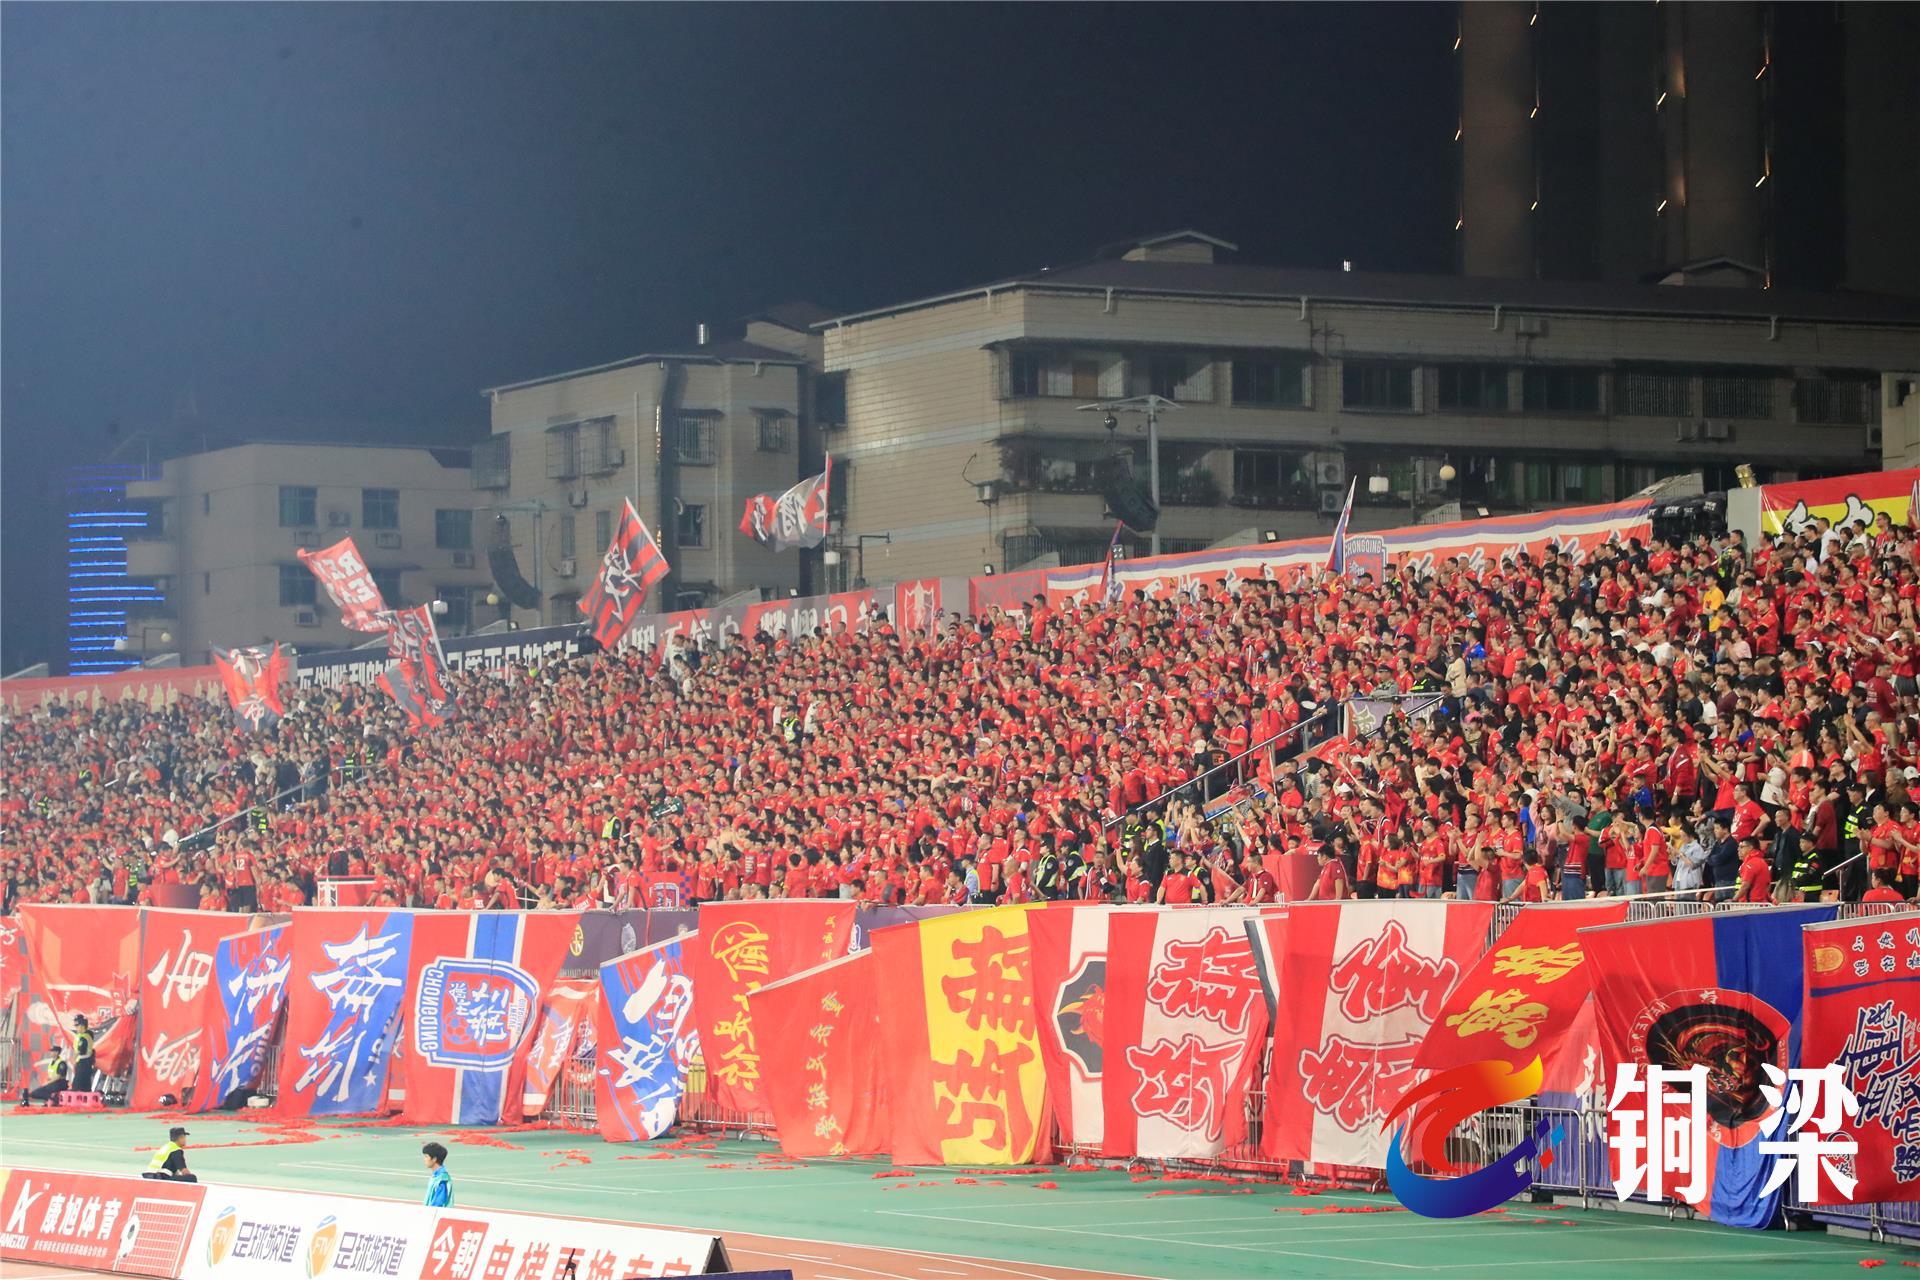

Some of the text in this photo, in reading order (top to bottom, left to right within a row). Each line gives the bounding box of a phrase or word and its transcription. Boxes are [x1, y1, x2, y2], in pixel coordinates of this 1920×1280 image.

[40, 1194, 123, 1240] 康旭体育
[231, 1221, 301, 1263] 足球频道
[333, 1231, 408, 1276] 足球频道
[430, 1226, 483, 1280] 今朝
